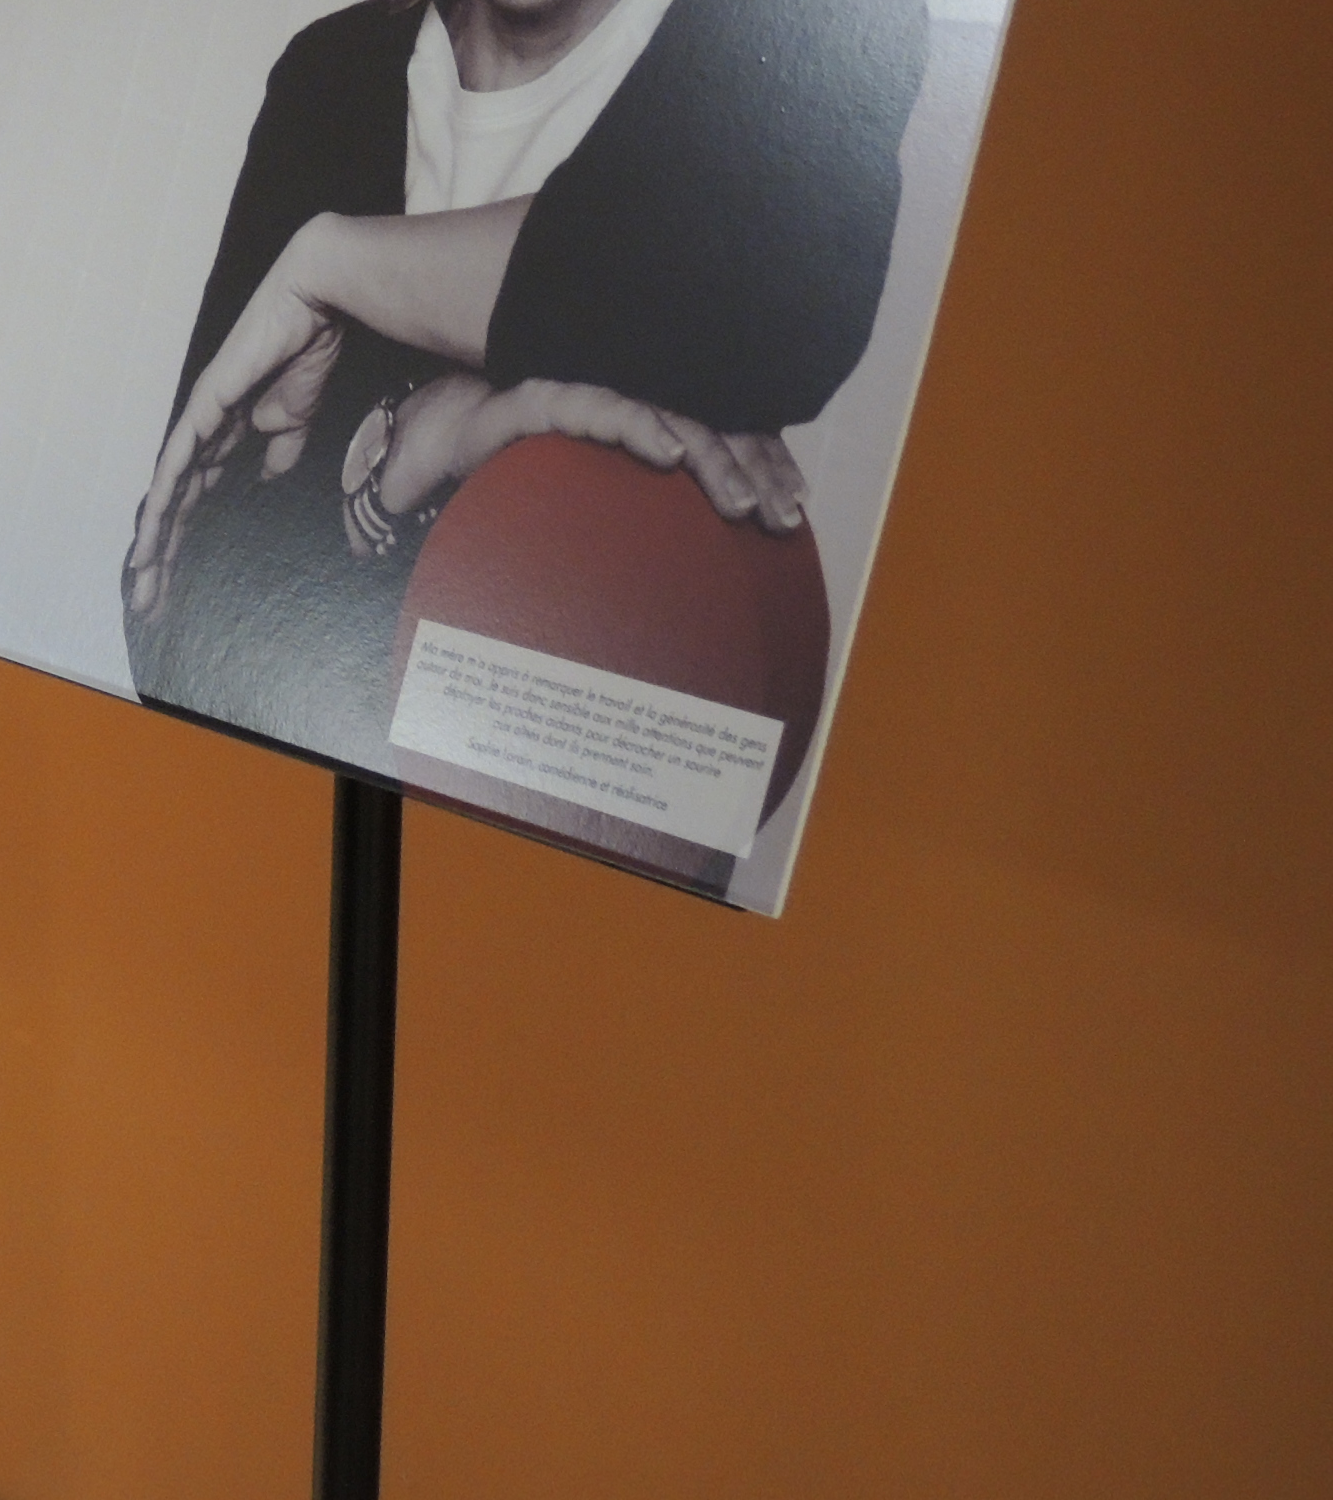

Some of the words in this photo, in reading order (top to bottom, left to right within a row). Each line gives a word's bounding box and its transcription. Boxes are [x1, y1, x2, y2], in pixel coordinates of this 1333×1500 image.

[416, 660, 447, 676] autour
[449, 667, 462, 680] de
[501, 685, 519, 697] suis
[522, 689, 547, 706] donc
[550, 700, 591, 719] sensible
[592, 713, 612, 725] aux
[614, 718, 641, 734] mille
[642, 726, 693, 749] attentions
[694, 743, 717, 757] que
[718, 750, 765, 771] peuvent
[421, 641, 438, 655] Ma
[441, 648, 465, 662] mère
[488, 663, 519, 678] appris
[521, 670, 530, 681] à
[531, 675, 584, 697] remarquer
[586, 688, 597, 701] le
[598, 692, 633, 712] travail
[633, 703, 645, 715] et
[647, 706, 658, 719] la
[657, 711, 717, 736] générosité
[718, 727, 738, 743] des
[739, 736, 768, 751] gens
[443, 684, 487, 707] déployer
[488, 697, 502, 711] les
[502, 705, 543, 723] proches
[545, 716, 583, 736] aidants
[584, 730, 608, 743] pour
[611, 735, 665, 761] décrocher
[667, 754, 682, 766] un
[684, 760, 722, 778] sourire
[467, 738, 500, 758] Sophie
[538, 763, 598, 789] comédienne
[599, 781, 611, 793] et
[611, 785, 669, 811] réalisatrice
[492, 720, 511, 733] aux
[542, 733, 568, 750] dont
[580, 748, 630, 769] prennent
